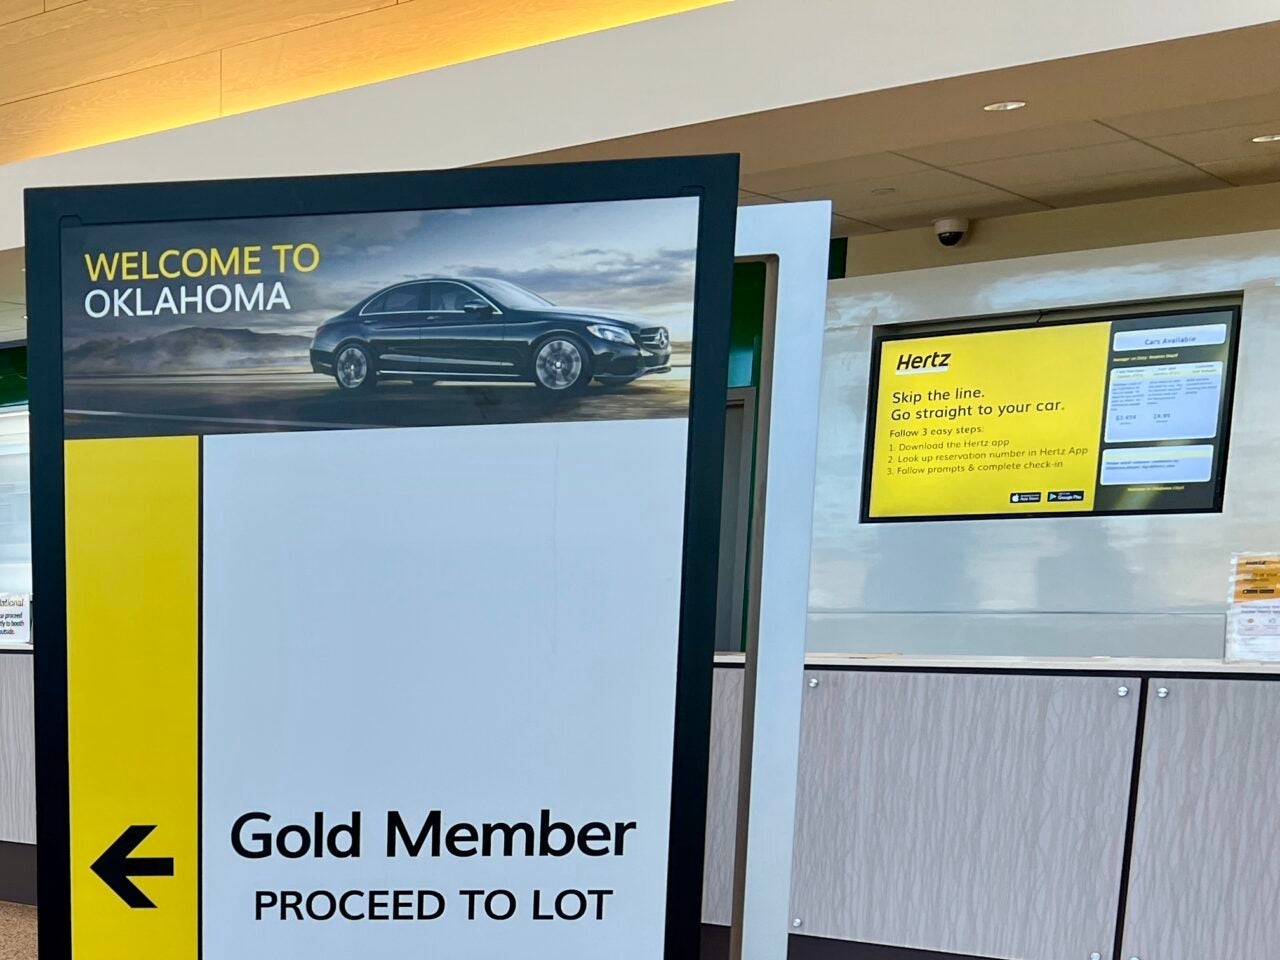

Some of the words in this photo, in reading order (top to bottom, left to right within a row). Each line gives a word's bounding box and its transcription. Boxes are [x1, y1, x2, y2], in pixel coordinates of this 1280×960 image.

[84, 245, 262, 282] WELCOME
[272, 243, 320, 274] TO
[84, 281, 292, 319] OKLAHOMA
[1145, 338, 1160, 346] Cars
[896, 351, 951, 371] Hertz
[892, 391, 922, 405] Skip
[927, 390, 950, 402] the
[955, 387, 985, 400] line.
[891, 409, 910, 421] Go
[916, 404, 972, 420] straight
[978, 404, 993, 416] to
[998, 402, 1031, 417] your
[1036, 400, 1065, 412] car.
[889, 428, 919, 439] Follow
[922, 427, 928, 437] 3
[930, 428, 952, 438] easy
[956, 425, 984, 436] steps:
[898, 442, 944, 452] Download
[946, 441, 961, 449] the
[964, 439, 988, 448] Hertz
[992, 439, 1010, 447] app
[898, 454, 919, 463] Look
[921, 455, 933, 464] up
[935, 452, 987, 462] reservation
[989, 450, 1025, 459] number
[1028, 448, 1037, 457] in
[1039, 447, 1066, 456] Hertz
[1069, 446, 1088, 456] App
[897, 465, 926, 475] Follow
[927, 464, 965, 475] prompts
[968, 464, 975, 472] &
[977, 461, 1021, 472] complete
[1024, 460, 1063, 469] check-in
[230, 810, 361, 859] Gold
[386, 808, 637, 858] Member
[254, 889, 446, 921] PROCEED
[459, 889, 517, 921] TO
[532, 889, 613, 921] LOT
